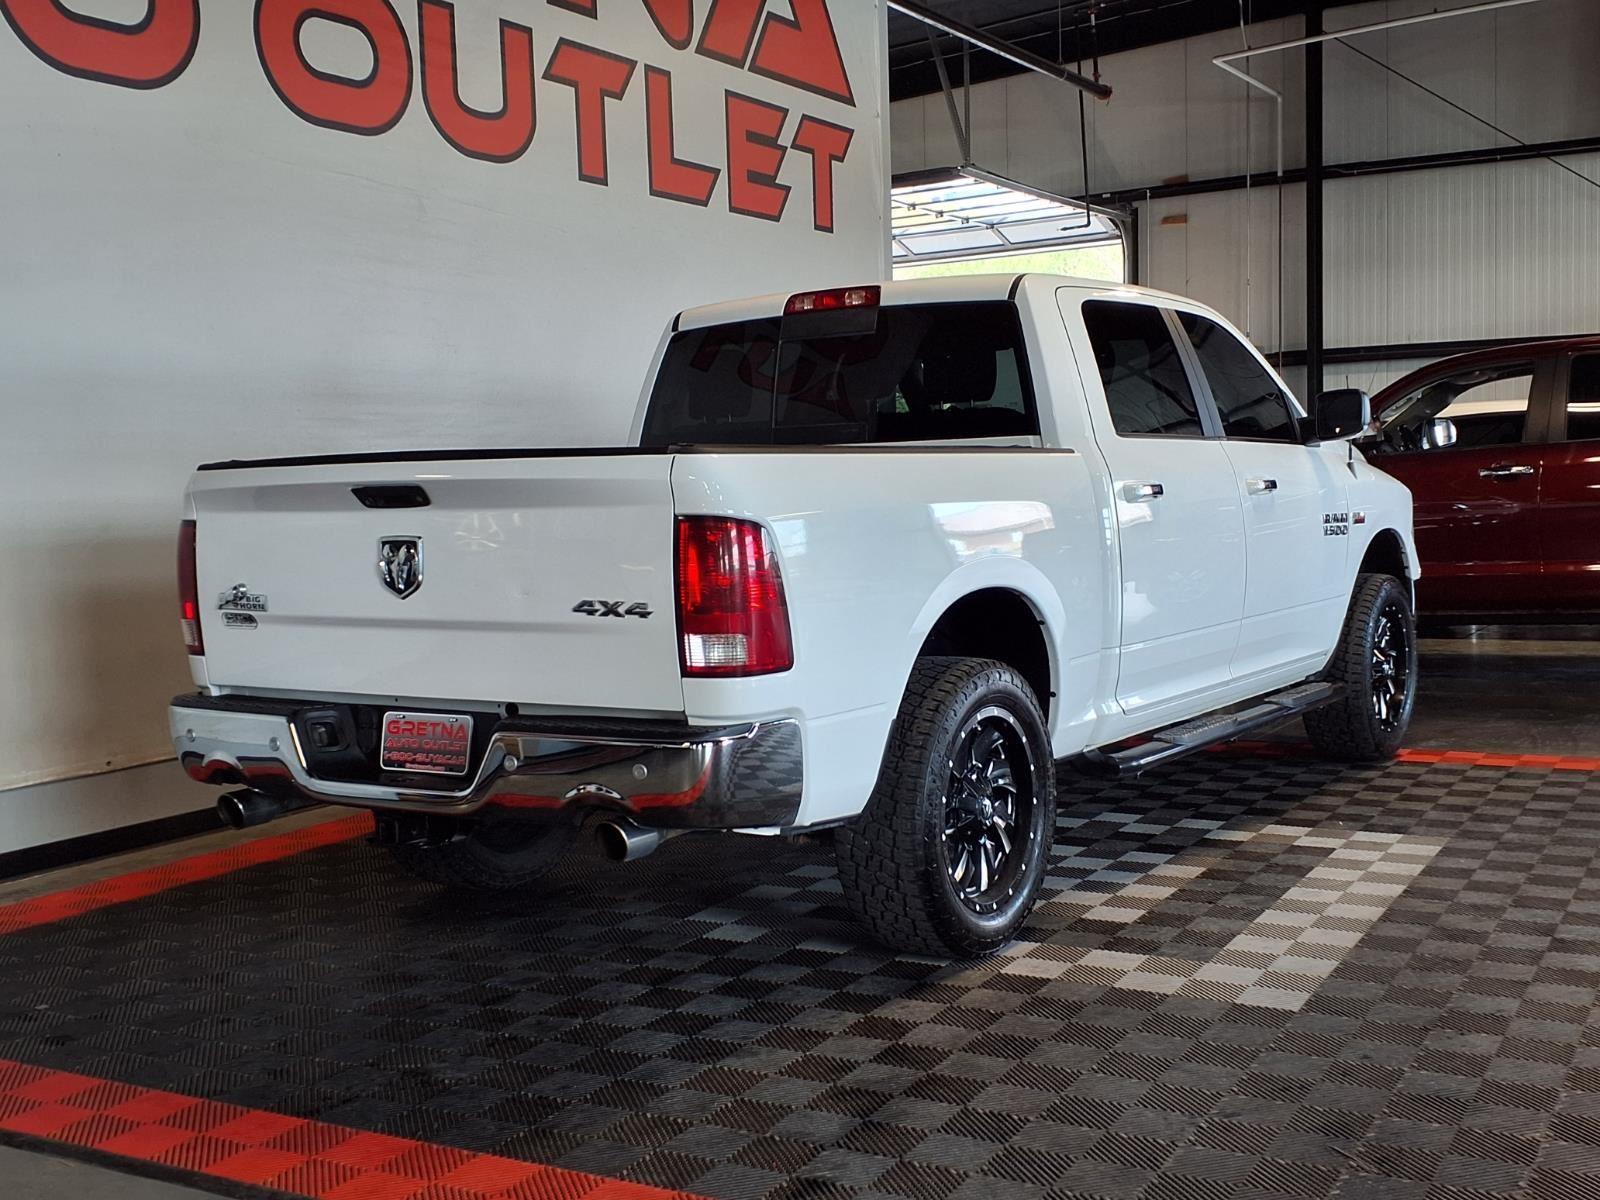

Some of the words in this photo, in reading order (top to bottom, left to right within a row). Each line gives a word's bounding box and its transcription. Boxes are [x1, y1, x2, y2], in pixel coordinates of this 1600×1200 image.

[253, 0, 856, 234] OUTLET
[1322, 512, 1348, 524] RAM
[1323, 525, 1348, 536] 1500
[240, 602, 265, 610] HORN
[387, 719, 468, 740] GRETNA
[385, 737, 420, 749] AUTO
[423, 739, 467, 752] OUTLET
